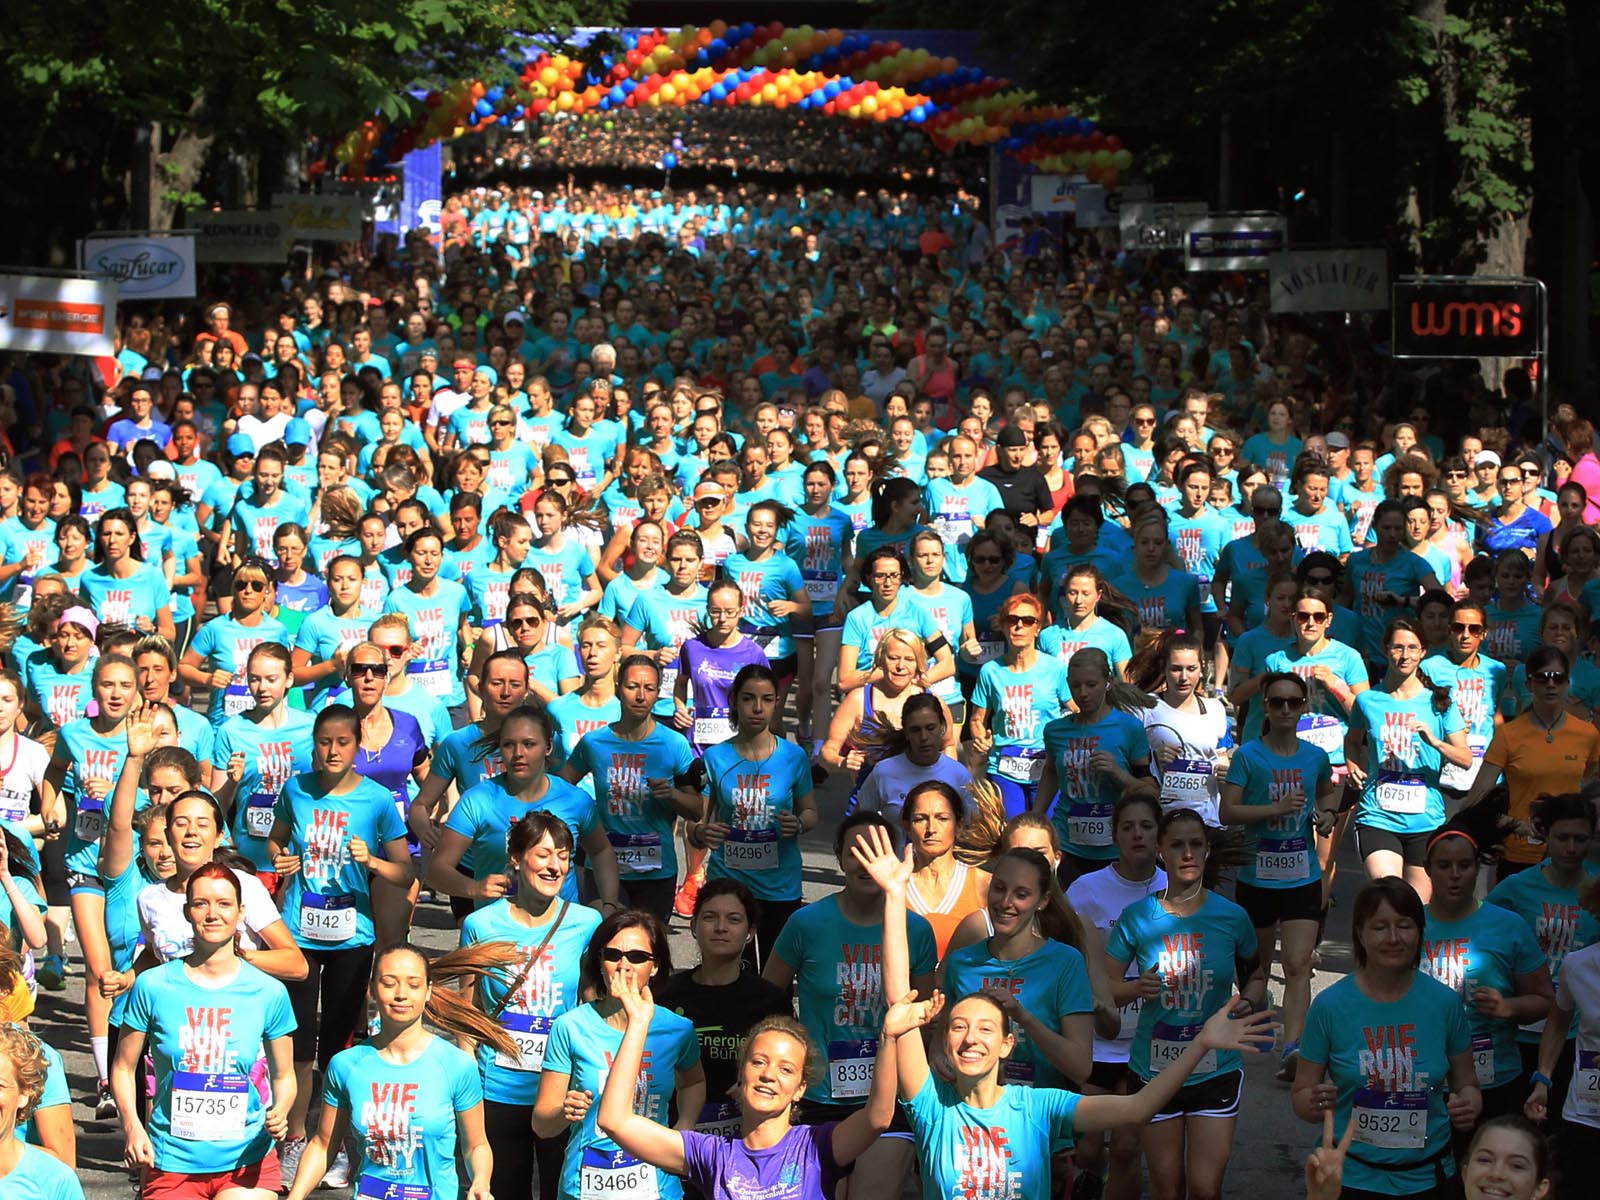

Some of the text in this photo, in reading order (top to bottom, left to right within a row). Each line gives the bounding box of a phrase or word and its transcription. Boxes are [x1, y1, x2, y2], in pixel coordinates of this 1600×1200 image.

[97, 252, 177, 284] SanLucar
[85, 749, 119, 767] VIE
[259, 741, 293, 759] VIE
[611, 753, 647, 771] VIE
[737, 774, 771, 791] VIE
[1164, 776, 1200, 790] 32565
[1272, 769, 1303, 785] VIE
[731, 788, 767, 806] RUN
[1379, 787, 1411, 801] 16751
[313, 809, 350, 829] VIE
[1074, 821, 1104, 834] 1769
[304, 825, 344, 844] RUN
[725, 843, 763, 859] 34296
[1259, 855, 1296, 869] 16493
[306, 912, 339, 928] 9142
[1542, 902, 1581, 923] VIE
[1163, 933, 1204, 955] VIE
[1424, 938, 1470, 961] VIE
[1159, 951, 1202, 975] RUN
[186, 1007, 232, 1031] VIE
[179, 1025, 228, 1051] RUN
[1363, 1024, 1417, 1051] VIE
[1359, 1047, 1414, 1077] RUN
[175, 1095, 239, 1115] 15735 C
[372, 1083, 419, 1107] VIE
[361, 1101, 410, 1131] RUN
[1359, 1112, 1419, 1132] 9532 C
[962, 1126, 1009, 1151] VIE
[953, 1144, 1008, 1173] RUN
[585, 1165, 649, 1192] 13466 C
